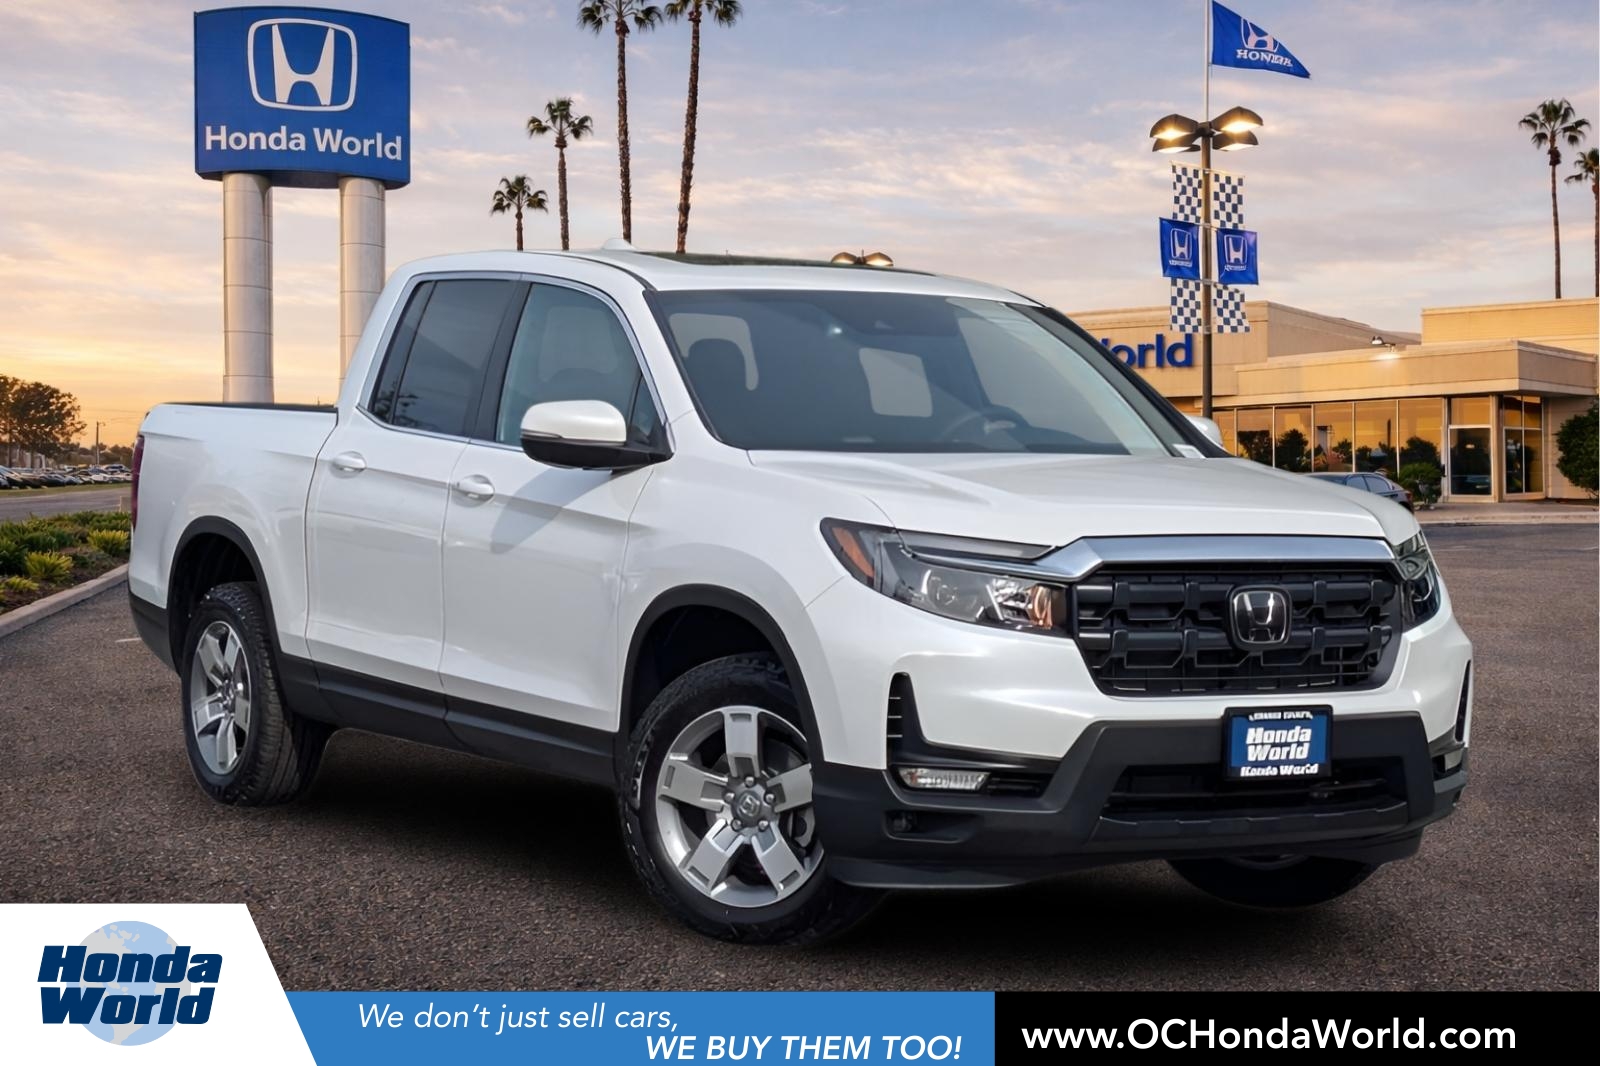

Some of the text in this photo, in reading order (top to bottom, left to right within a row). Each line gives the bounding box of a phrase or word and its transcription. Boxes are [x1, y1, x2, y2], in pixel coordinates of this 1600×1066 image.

[205, 125, 402, 161] Honda World
[1100, 333, 1193, 368] orld
[1246, 726, 1312, 744] Honda
[1247, 742, 1310, 762] World
